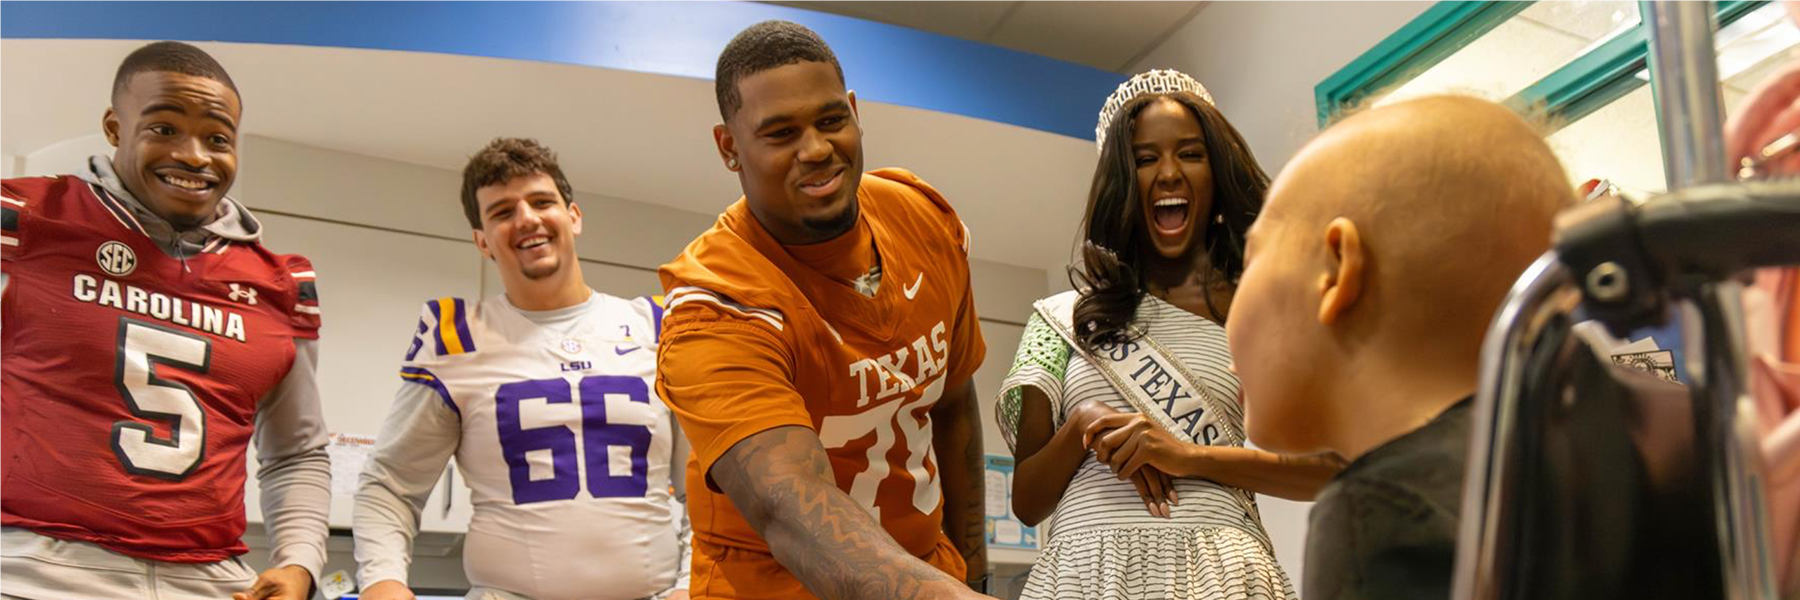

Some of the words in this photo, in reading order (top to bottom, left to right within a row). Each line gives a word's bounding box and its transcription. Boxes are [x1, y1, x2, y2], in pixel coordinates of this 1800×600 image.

[100, 243, 134, 273] SEC
[73, 274, 247, 342] CAROLINA
[619, 325, 630, 337] 7
[113, 318, 210, 479] 5
[560, 361, 592, 372] LSU
[850, 321, 948, 407] TEXAS
[1130, 355, 1219, 445] TEXAS
[495, 375, 652, 505] 66
